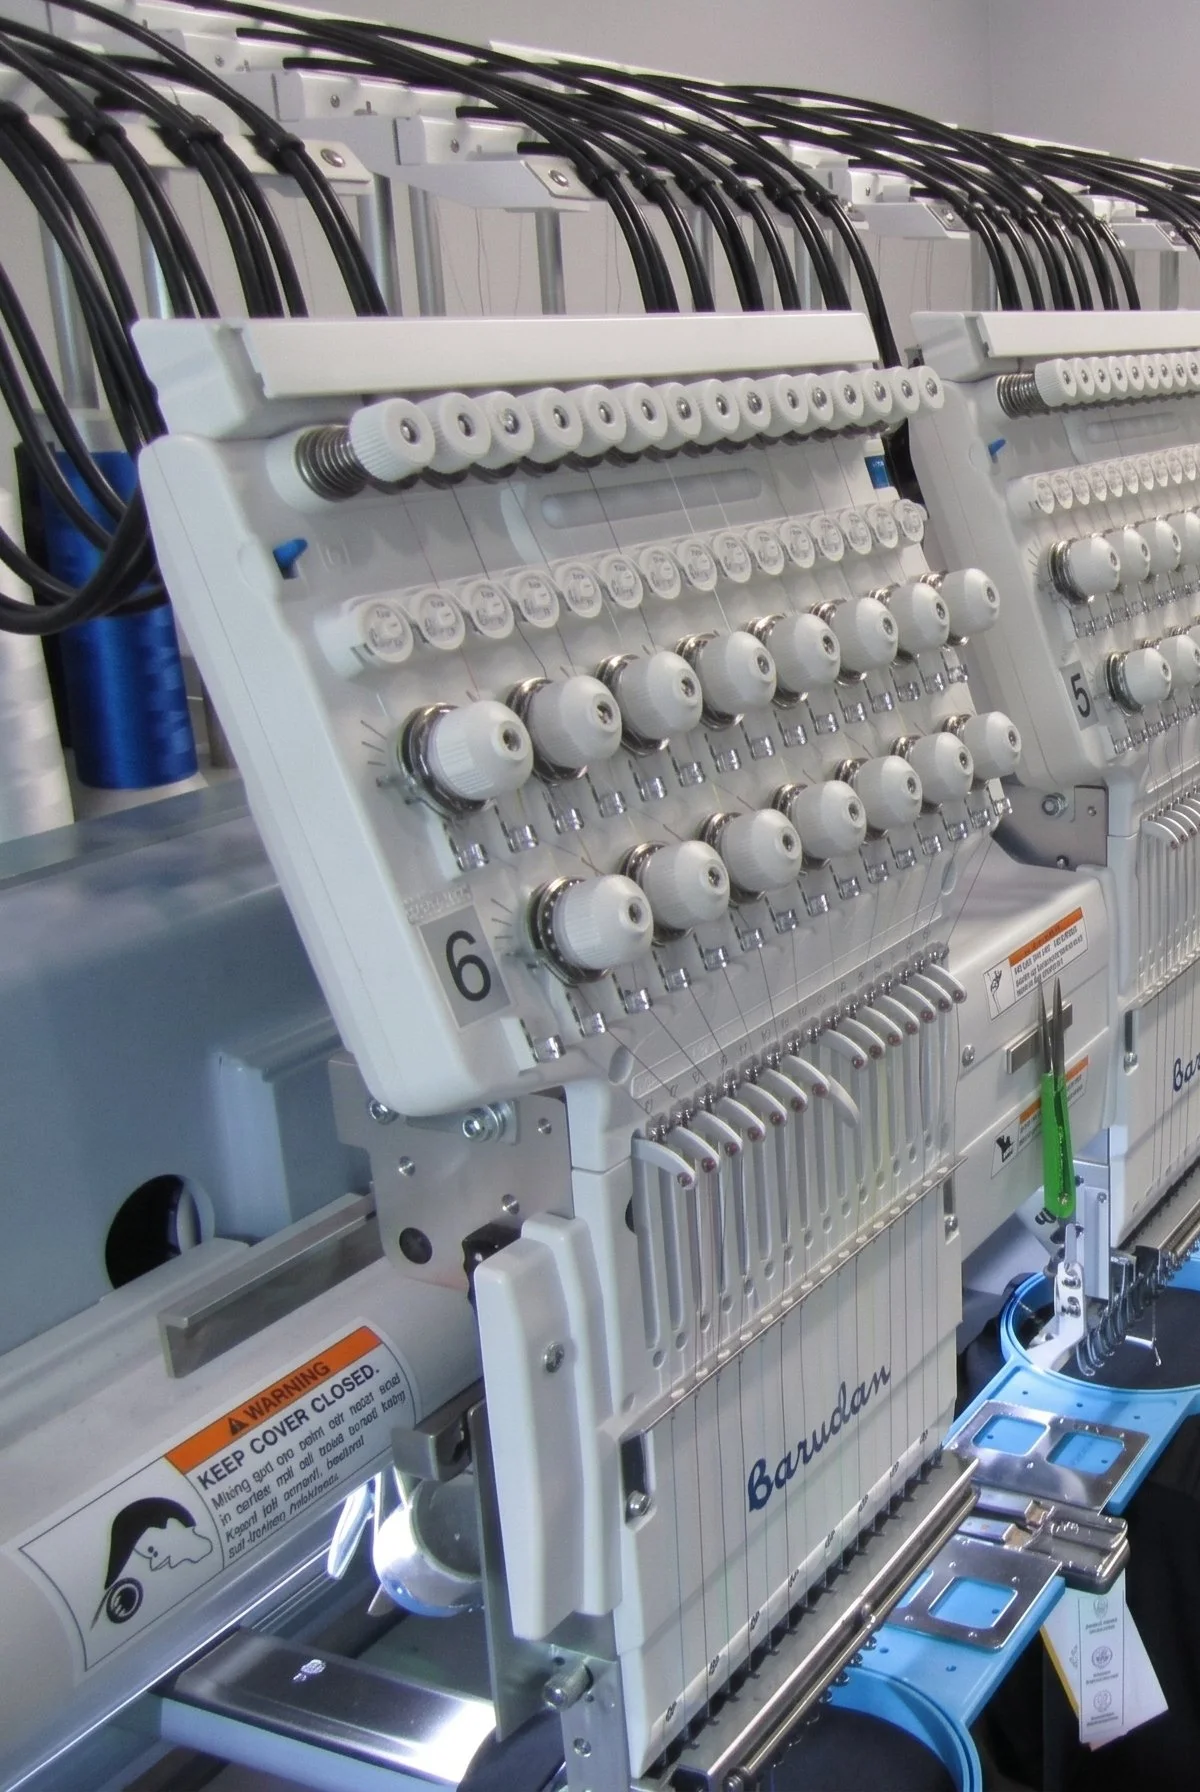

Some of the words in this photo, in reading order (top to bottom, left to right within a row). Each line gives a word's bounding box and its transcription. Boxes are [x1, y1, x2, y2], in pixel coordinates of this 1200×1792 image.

[1070, 672, 1091, 718] 5
[445, 930, 492, 1002] 6
[197, 1449, 245, 1490] KEEP
[250, 1408, 310, 1455] COVER
[310, 1363, 380, 1413] CLOSED.
[243, 1361, 331, 1421] WARNING
[747, 1365, 892, 1512] Barudan
